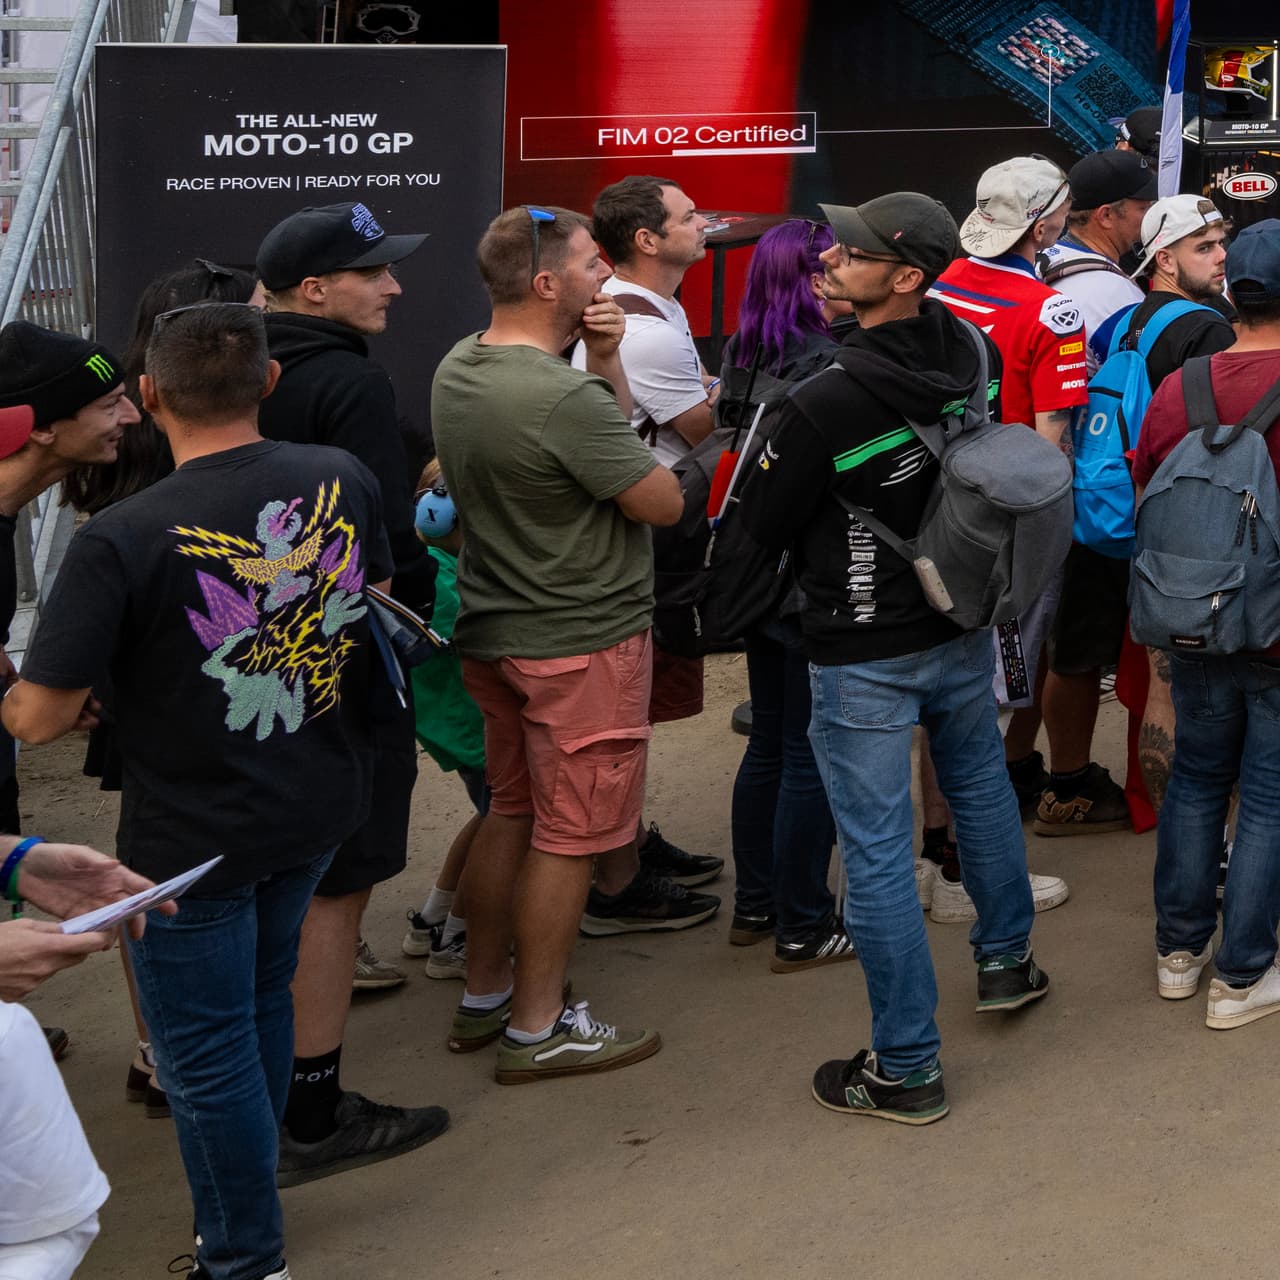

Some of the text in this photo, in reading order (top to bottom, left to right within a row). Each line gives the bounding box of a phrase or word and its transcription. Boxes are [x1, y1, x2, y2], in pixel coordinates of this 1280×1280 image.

[236, 113, 378, 128] THE ALL-NEW
[597, 123, 807, 146] FIM 02 Certified
[204, 132, 414, 157] MOTO-10 GP
[166, 173, 441, 191] RACE PROVEN READY FOR YOU
[1232, 180, 1270, 193] BELL
[294, 1065, 336, 1083] FOX
